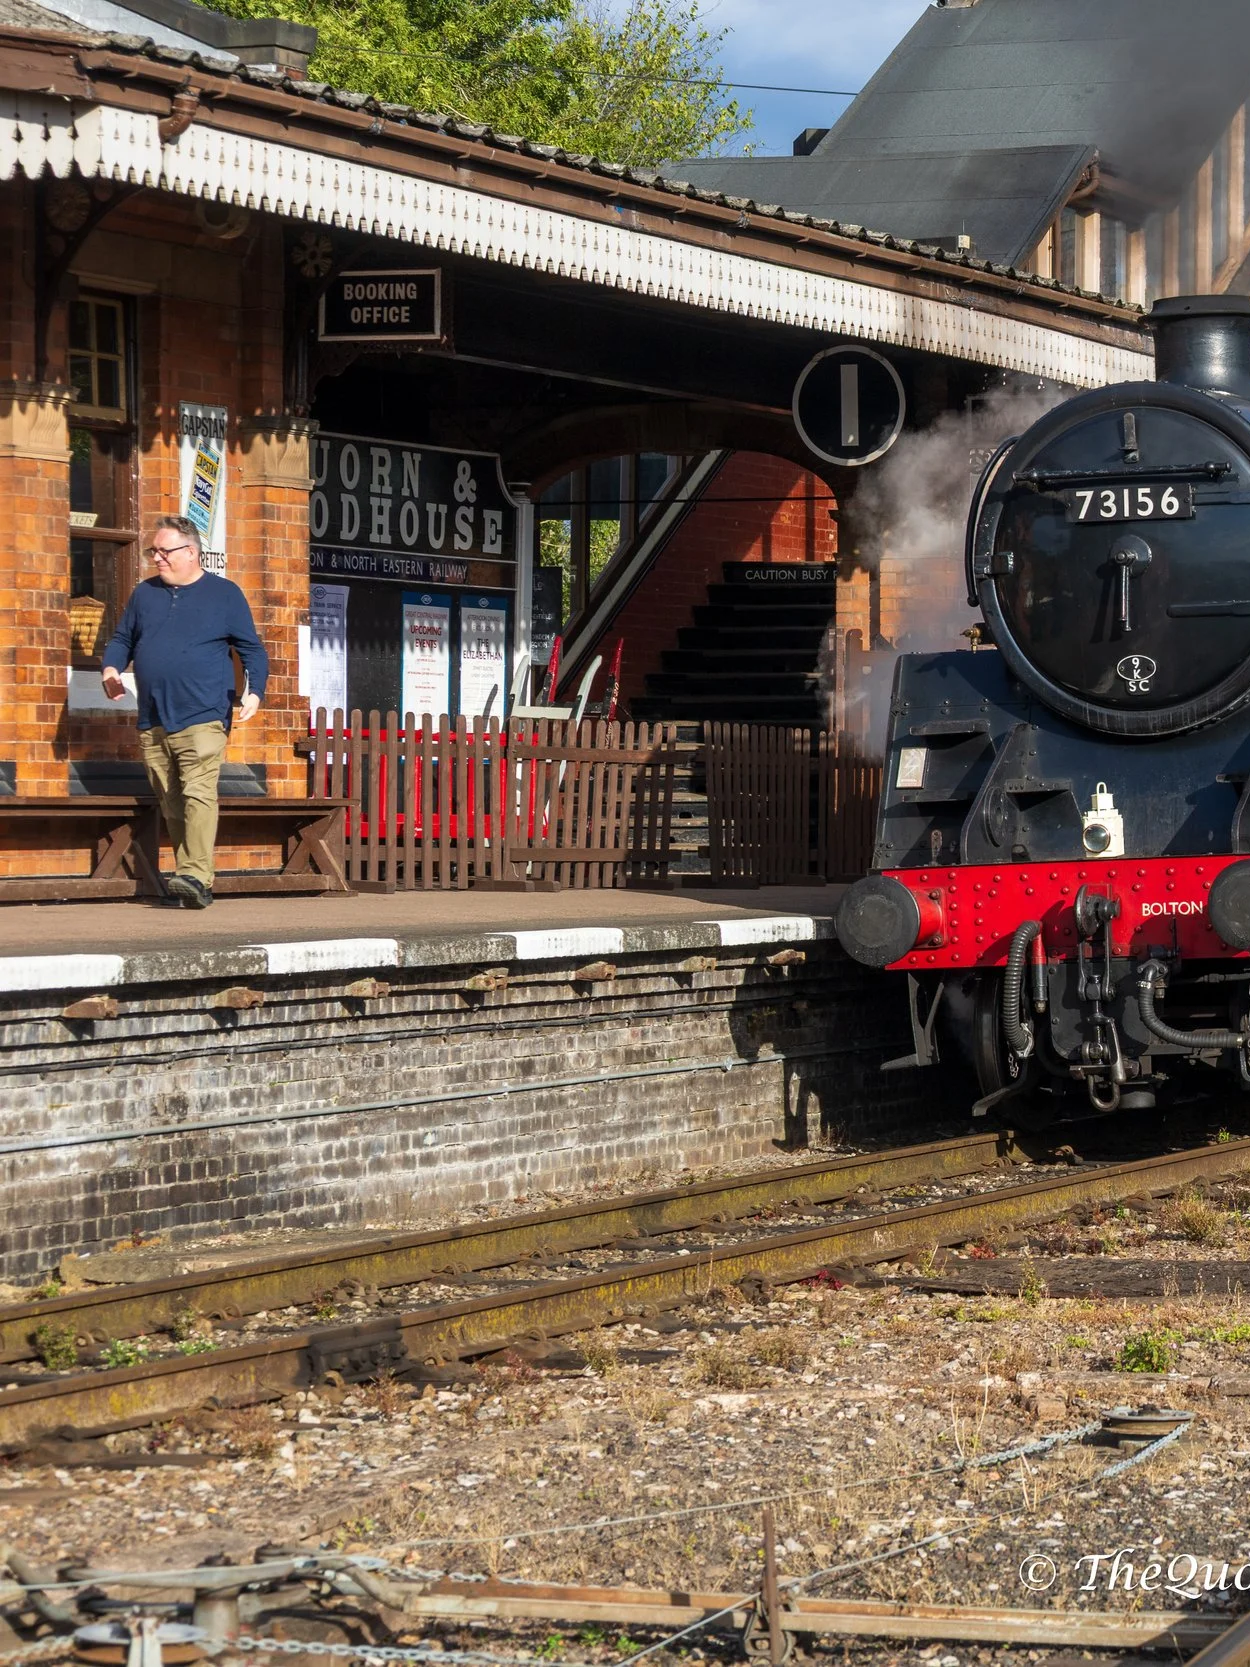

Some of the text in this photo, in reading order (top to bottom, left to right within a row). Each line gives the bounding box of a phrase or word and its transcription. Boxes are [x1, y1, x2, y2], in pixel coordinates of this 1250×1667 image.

[343, 282, 417, 300] BOOKING
[351, 306, 410, 323] OFFICE
[181, 413, 225, 439] CAPSTAN
[453, 460, 477, 503] &
[1075, 486, 1180, 520] 73156
[331, 555, 339, 568] &
[343, 555, 377, 572] NORTH
[383, 558, 424, 576] EASTERN
[429, 562, 468, 579] RAILWAY
[745, 570, 797, 580] CAUTION
[802, 570, 828, 580] BUSY
[410, 625, 442, 636] UPCOMING
[415, 638, 438, 649] EVENTS
[477, 638, 489, 648] THE
[463, 650, 503, 660] ELIZABETHAN
[1131, 657, 1140, 669] 9
[1133, 669, 1141, 679] K
[1128, 680, 1150, 692] SC
[1141, 900, 1204, 917] BOLTON
